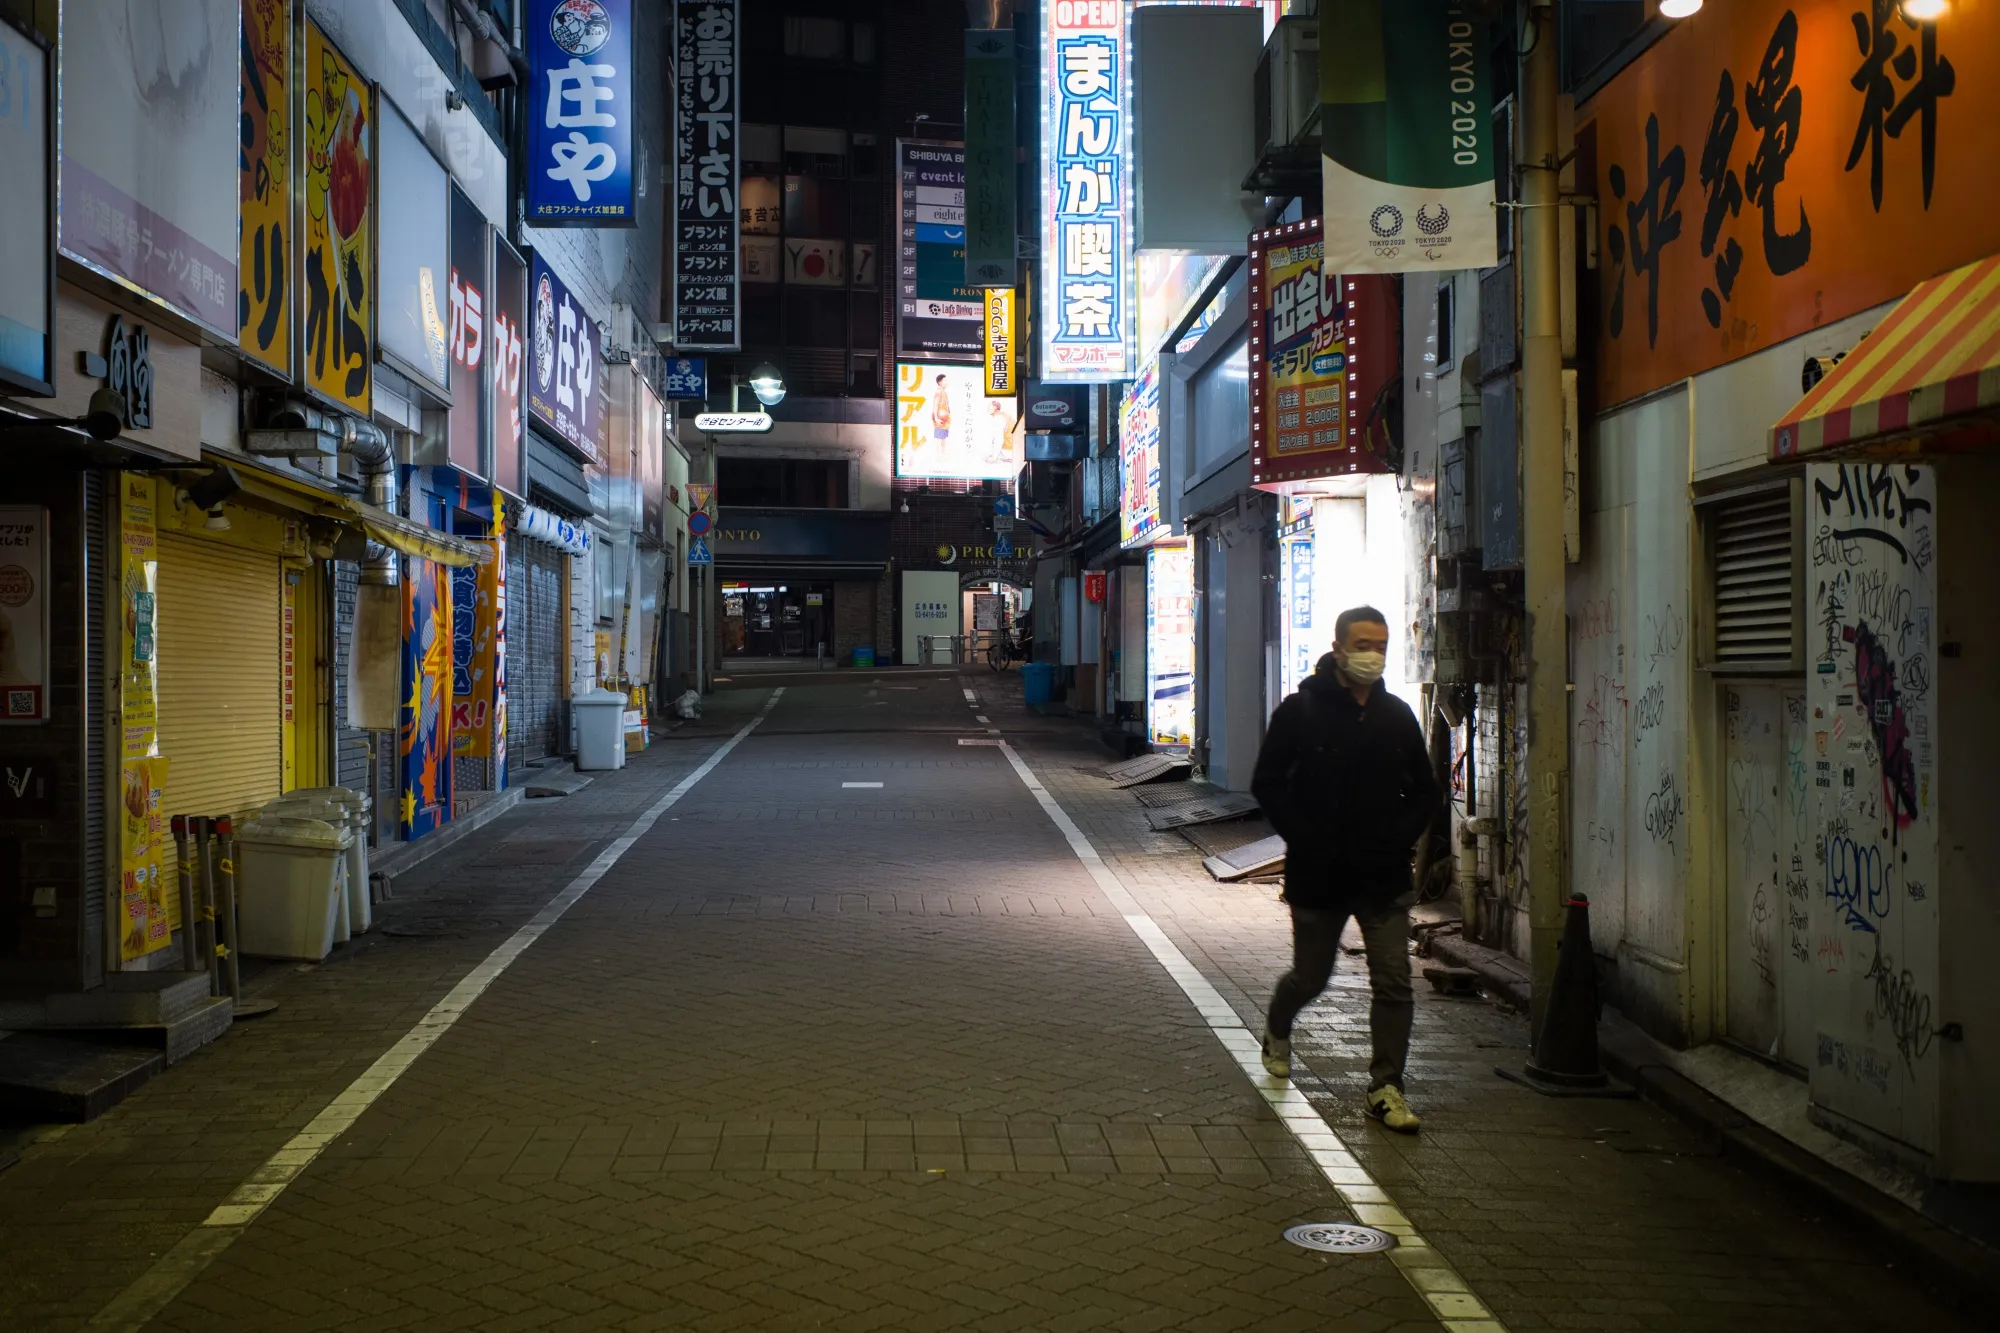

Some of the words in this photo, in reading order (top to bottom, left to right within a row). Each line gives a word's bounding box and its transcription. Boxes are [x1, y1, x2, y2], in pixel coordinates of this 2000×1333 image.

[1058, 1, 1116, 27] OPEN
[696, 5, 734, 218] お売り下さい
[545, 58, 617, 202] 庄や
[1451, 100, 1478, 165] 2020
[909, 150, 953, 163] SHIBUYA
[903, 172, 915, 180] 7F
[921, 171, 955, 183] event
[903, 190, 915, 199] 6F
[1062, 40, 1115, 338] まんが喫茶
[977, 150, 992, 249] GARDEN
[537, 205, 625, 214] 大庄フランチャイズ加盟店
[903, 209, 915, 218] 5F
[934, 207, 957, 222] eight
[684, 225, 728, 239] ブランド
[903, 228, 915, 237] 4F
[903, 248, 915, 256] 3F
[684, 256, 728, 270] ブランド
[903, 267, 915, 275] 2F
[684, 287, 728, 301] メンズ服
[904, 286, 915, 294] 1F
[904, 304, 915, 313] B1
[679, 319, 733, 332] レディース服
[1311, 320, 1345, 354] カフェ
[556, 292, 592, 427] 庄や
[1055, 347, 1123, 362] マンボー
[1271, 345, 1311, 379] キラリ
[667, 373, 702, 391] 庄や
[898, 364, 926, 449] リアル
[699, 417, 765, 426] 渋谷センター街
